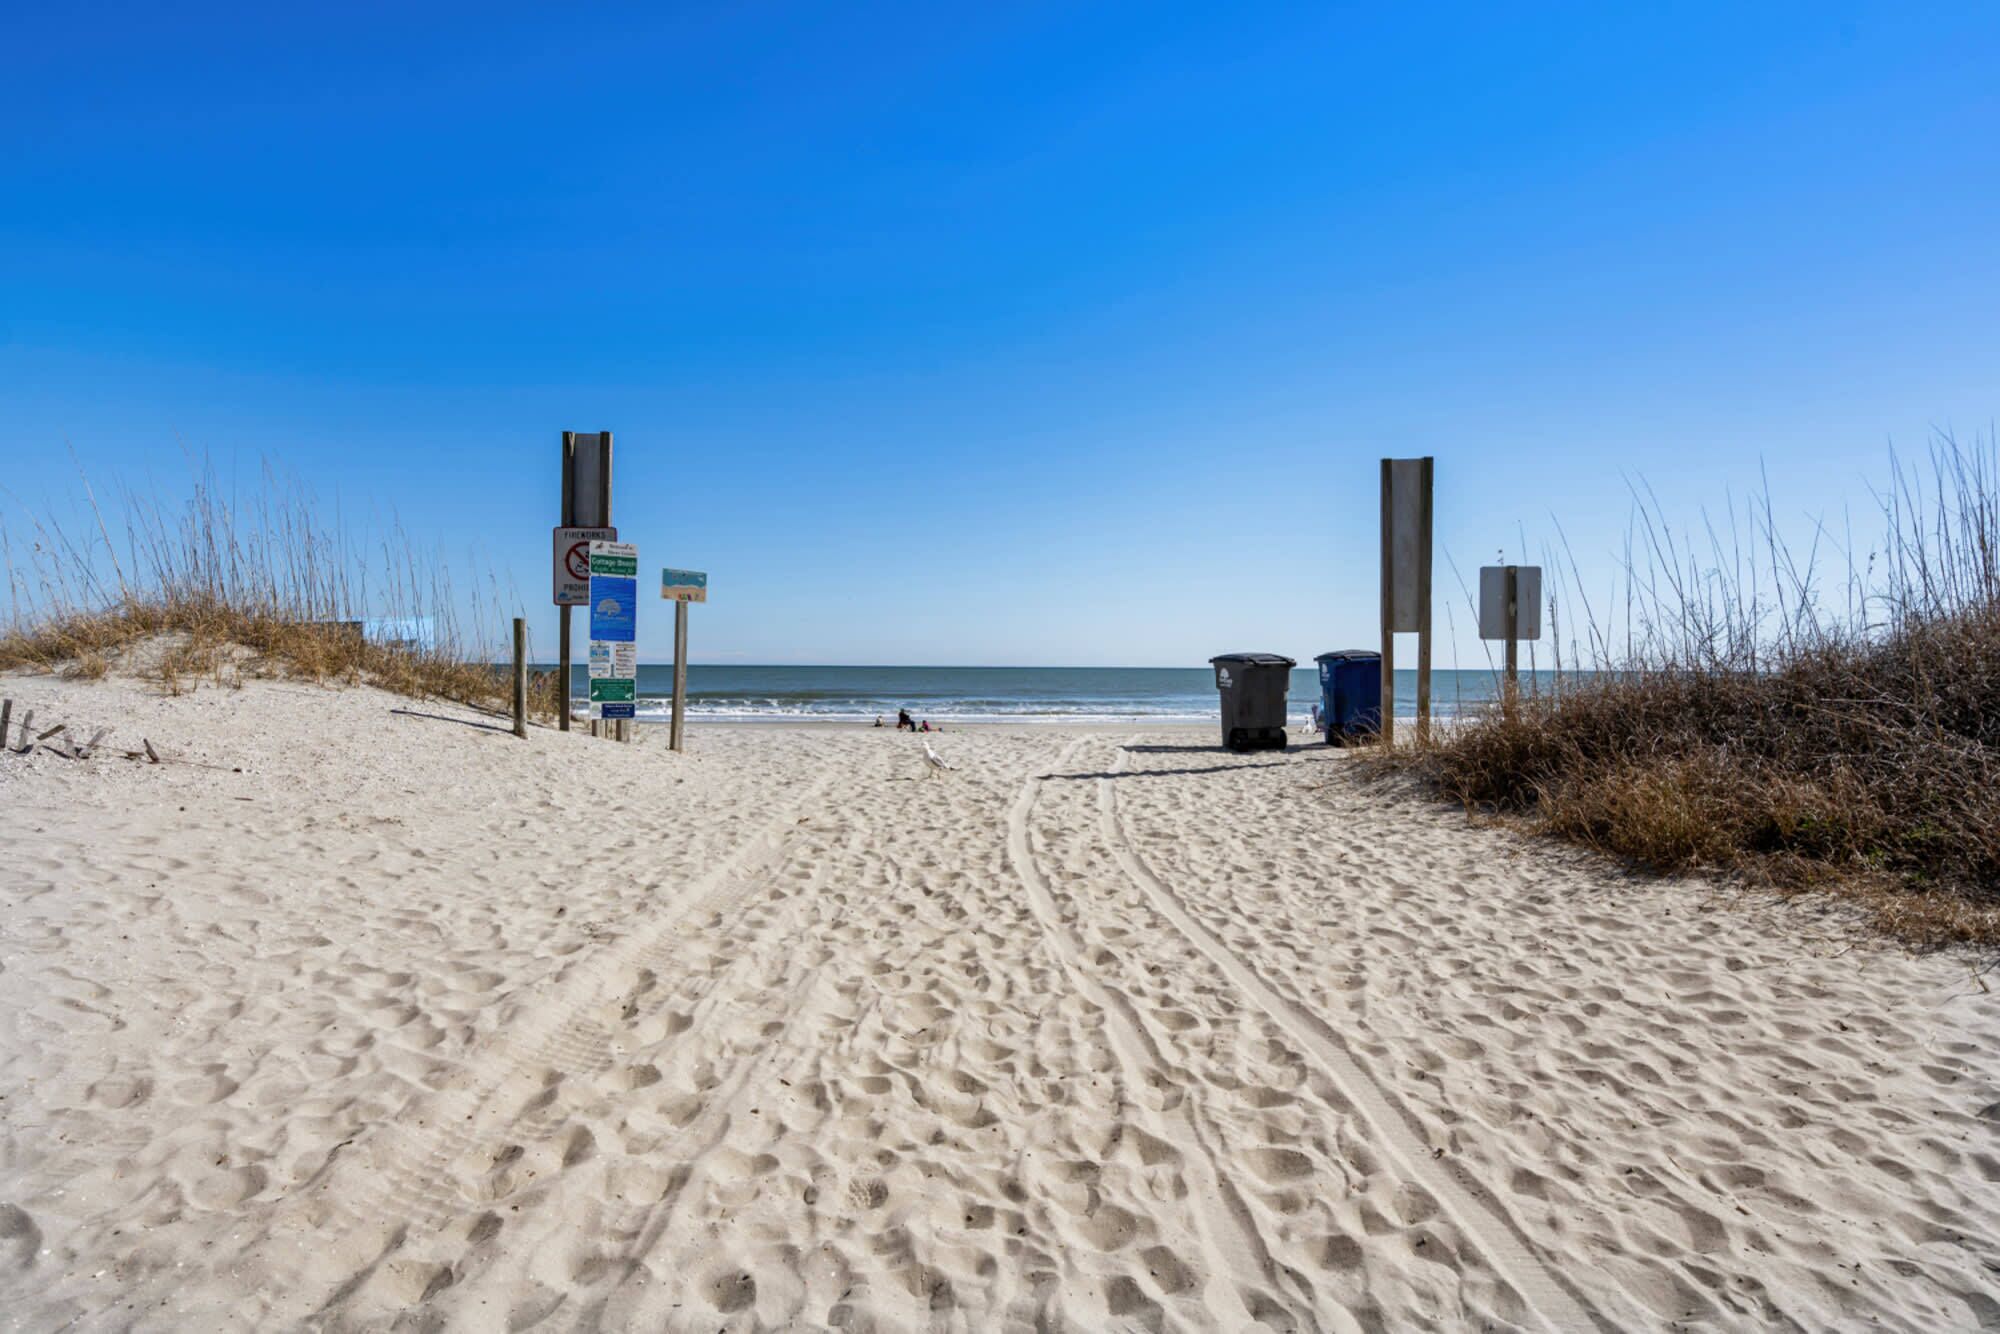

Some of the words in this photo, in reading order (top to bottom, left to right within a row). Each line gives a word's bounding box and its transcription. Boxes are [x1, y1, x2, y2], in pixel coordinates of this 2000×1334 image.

[564, 531, 606, 539] FIREWORKS
[591, 557, 616, 567] Cottage
[563, 583, 589, 592] PROHI
